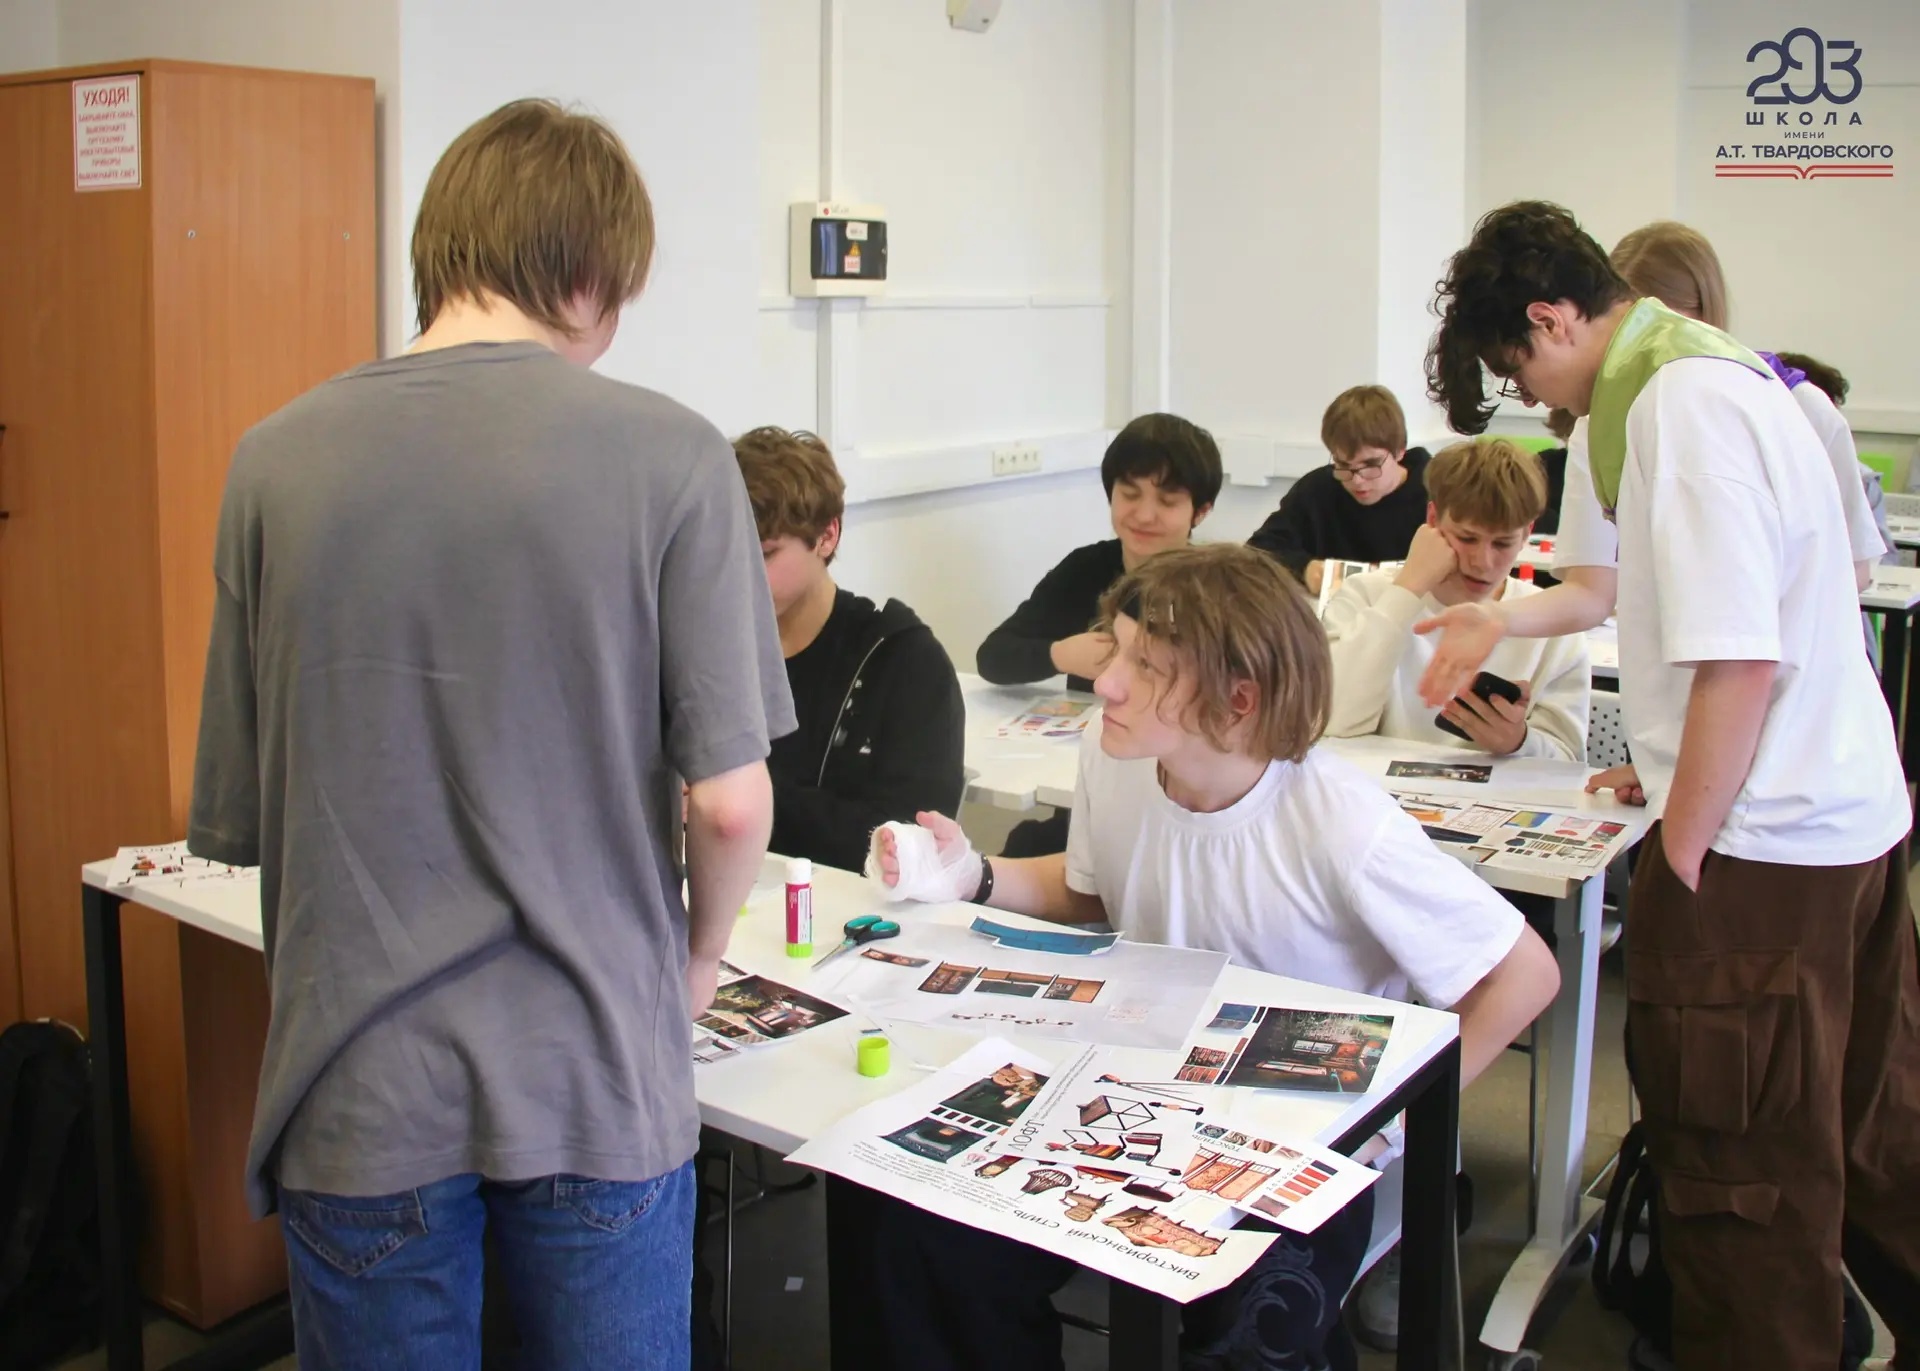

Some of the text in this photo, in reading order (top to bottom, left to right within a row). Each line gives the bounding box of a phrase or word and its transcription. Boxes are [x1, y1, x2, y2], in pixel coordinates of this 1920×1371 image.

[83, 86, 129, 107] УХОДЯ!
[1008, 1119, 1045, 1152] ЛОФТ
[1013, 1209, 1201, 1281] Викторианский стиль
